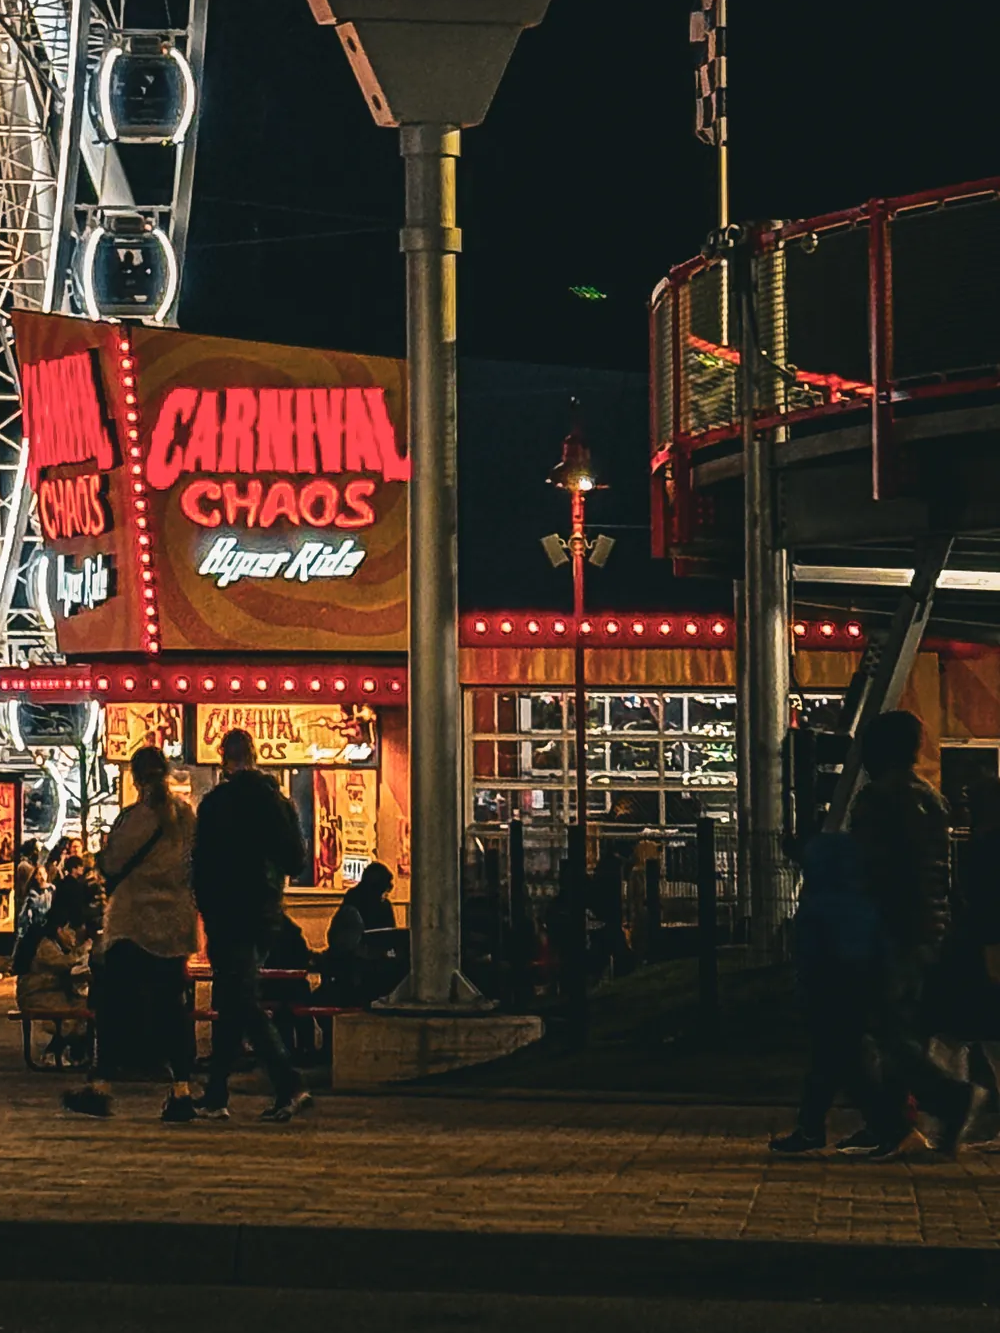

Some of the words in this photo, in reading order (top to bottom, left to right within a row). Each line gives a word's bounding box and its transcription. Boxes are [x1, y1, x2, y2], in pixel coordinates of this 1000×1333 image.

[146, 387, 411, 490] CARNIVAL
[40, 474, 105, 540] CHAOS
[181, 479, 376, 528] CHAOS
[199, 536, 292, 587] Hyper
[284, 539, 367, 583] Ride
